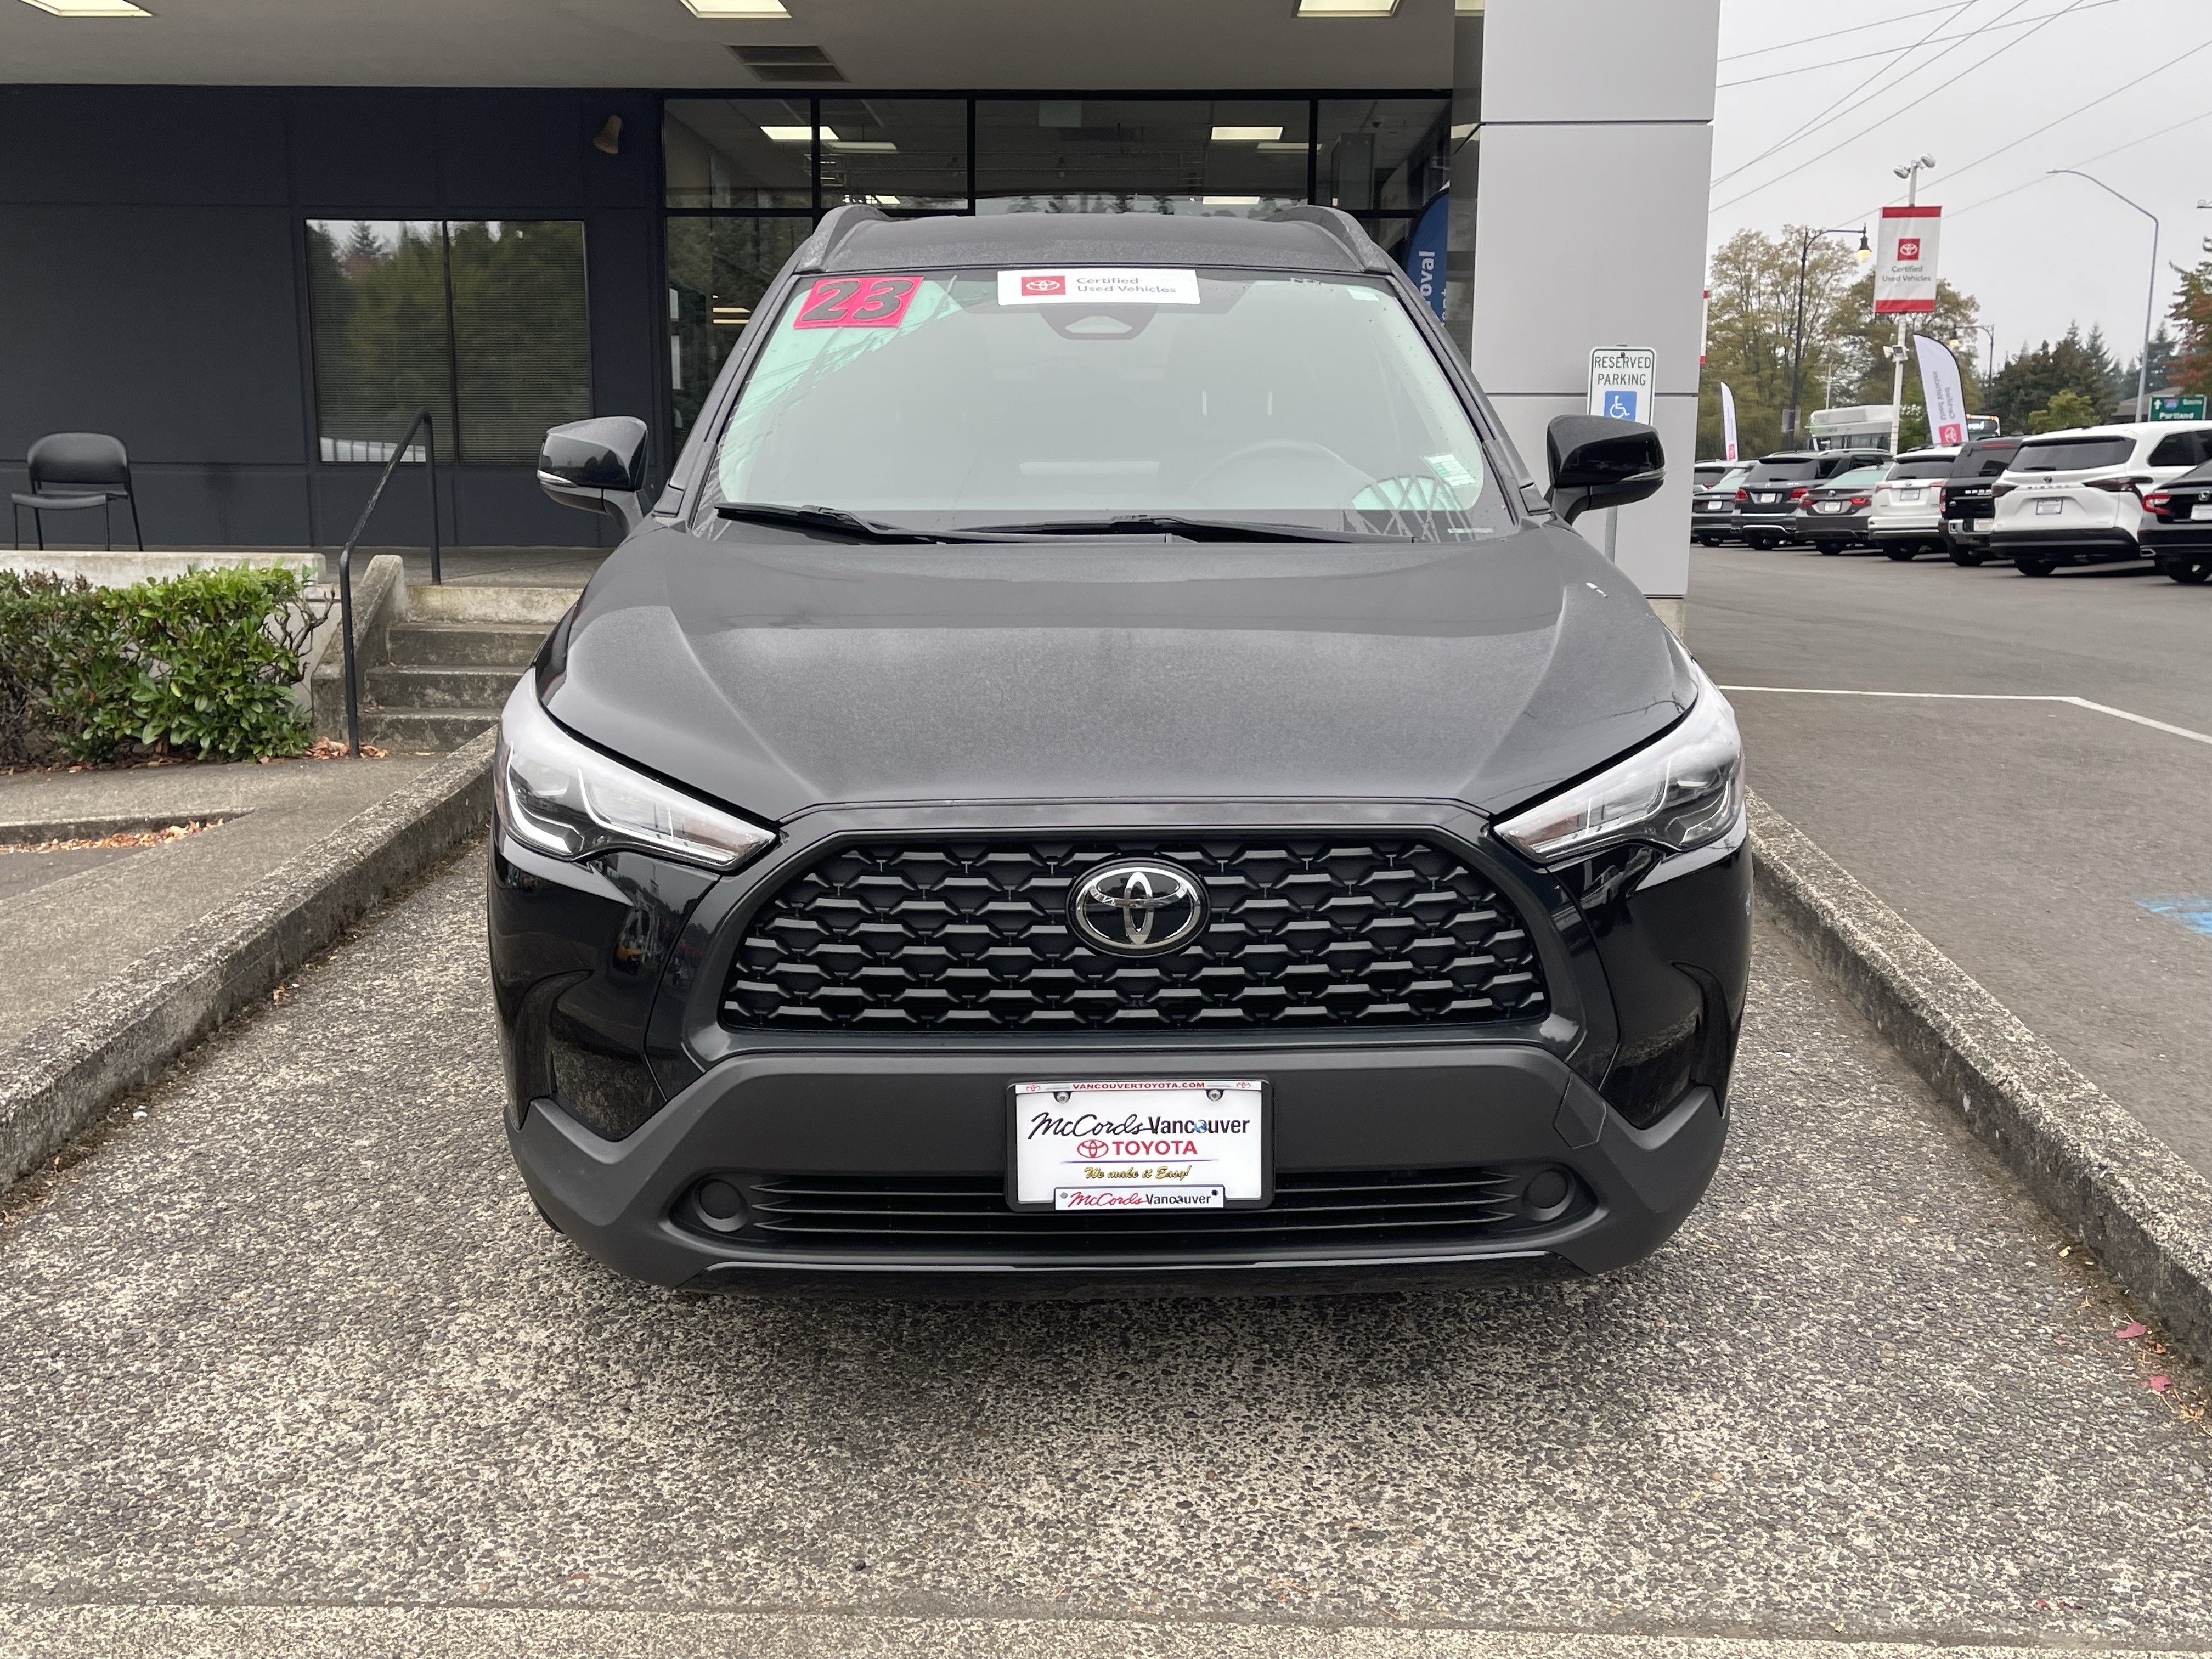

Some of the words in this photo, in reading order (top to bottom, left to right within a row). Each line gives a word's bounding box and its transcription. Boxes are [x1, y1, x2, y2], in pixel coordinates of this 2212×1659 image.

[1418, 251, 1435, 308] oval
[800, 279, 915, 323] 23
[1594, 356, 1651, 369] RESERVED
[1597, 373, 1646, 386] PARKING
[1111, 1140, 1198, 1156] TOYOTA
[1084, 1166, 1104, 1179] We
[1107, 1167, 1139, 1179] make
[1142, 1169, 1153, 1178] it
[1155, 1165, 1192, 1181] Easy!
